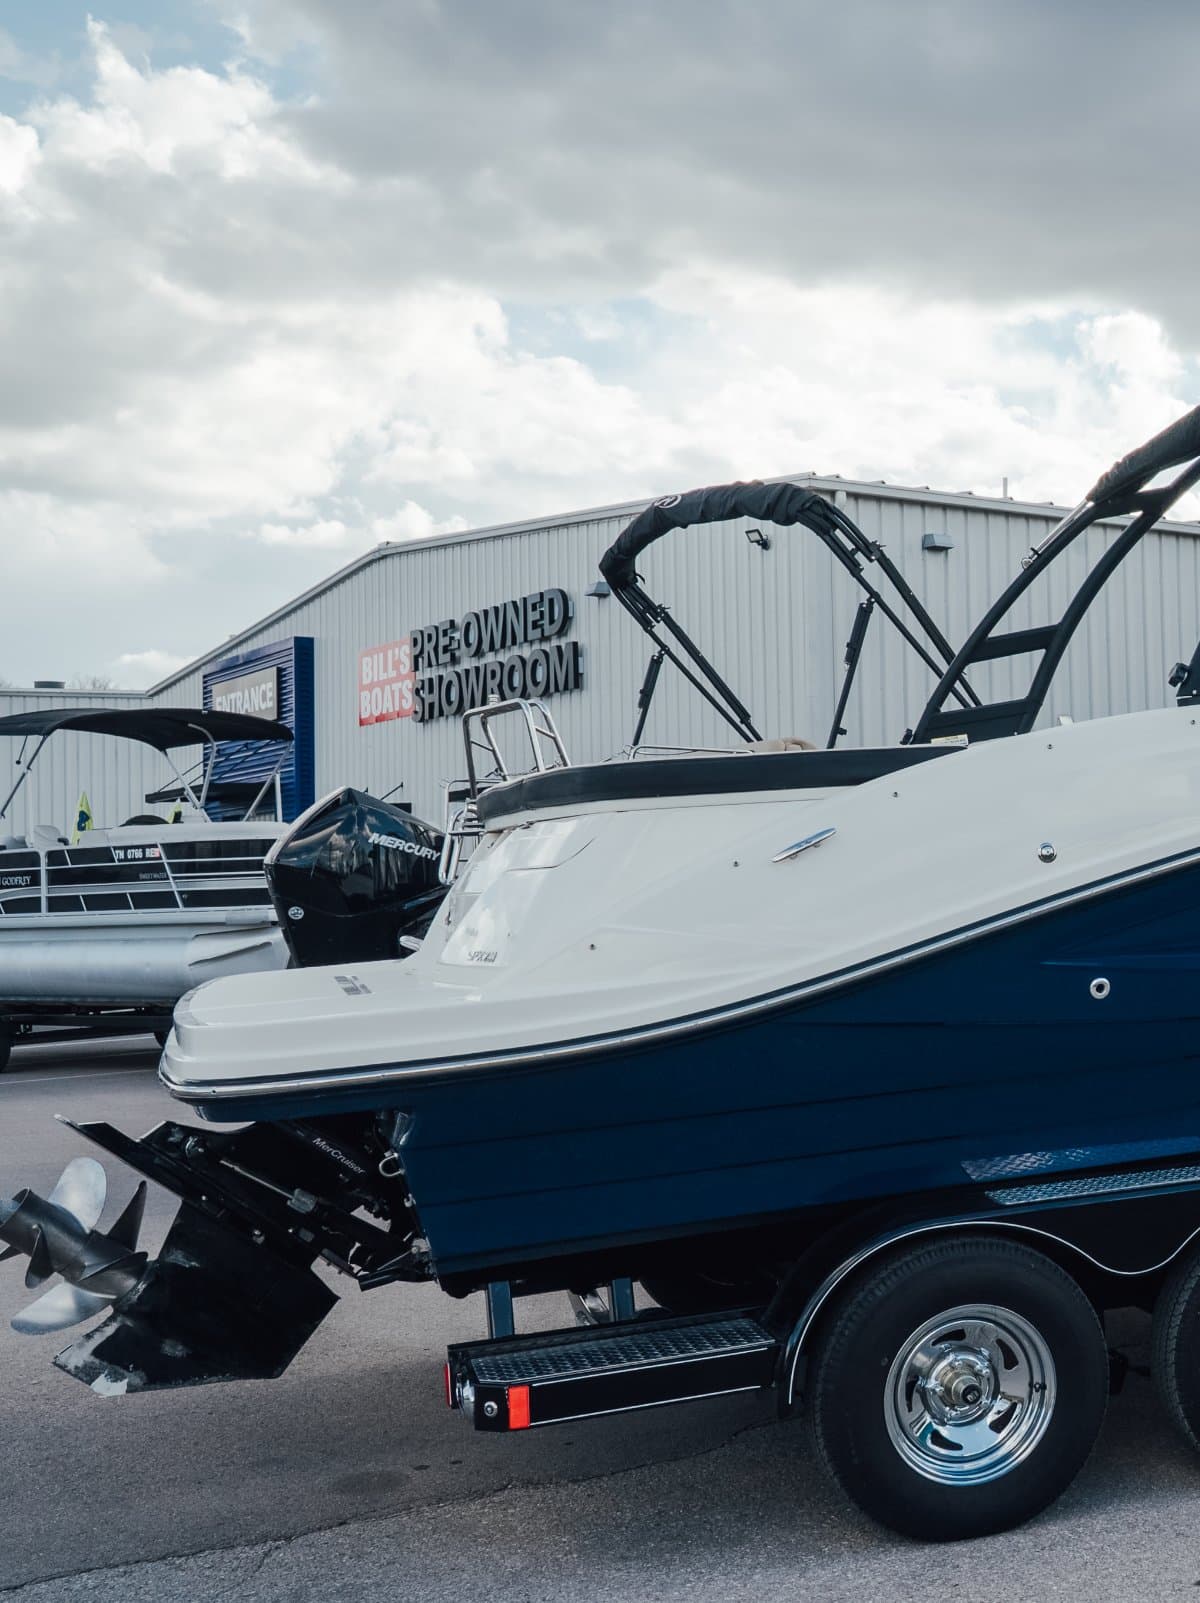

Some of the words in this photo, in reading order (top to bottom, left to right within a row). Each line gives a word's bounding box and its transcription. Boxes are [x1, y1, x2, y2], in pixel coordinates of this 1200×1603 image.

[410, 588, 569, 672] PRE-OWNED
[362, 645, 410, 685] BILL'S
[411, 641, 580, 723] SHOWROOM
[215, 681, 274, 714] ENTRANCE
[360, 679, 413, 719] BOATS
[368, 832, 441, 861] MERCURY
[1, 875, 32, 886] GODFREY
[312, 1137, 366, 1173] MerCruiser
